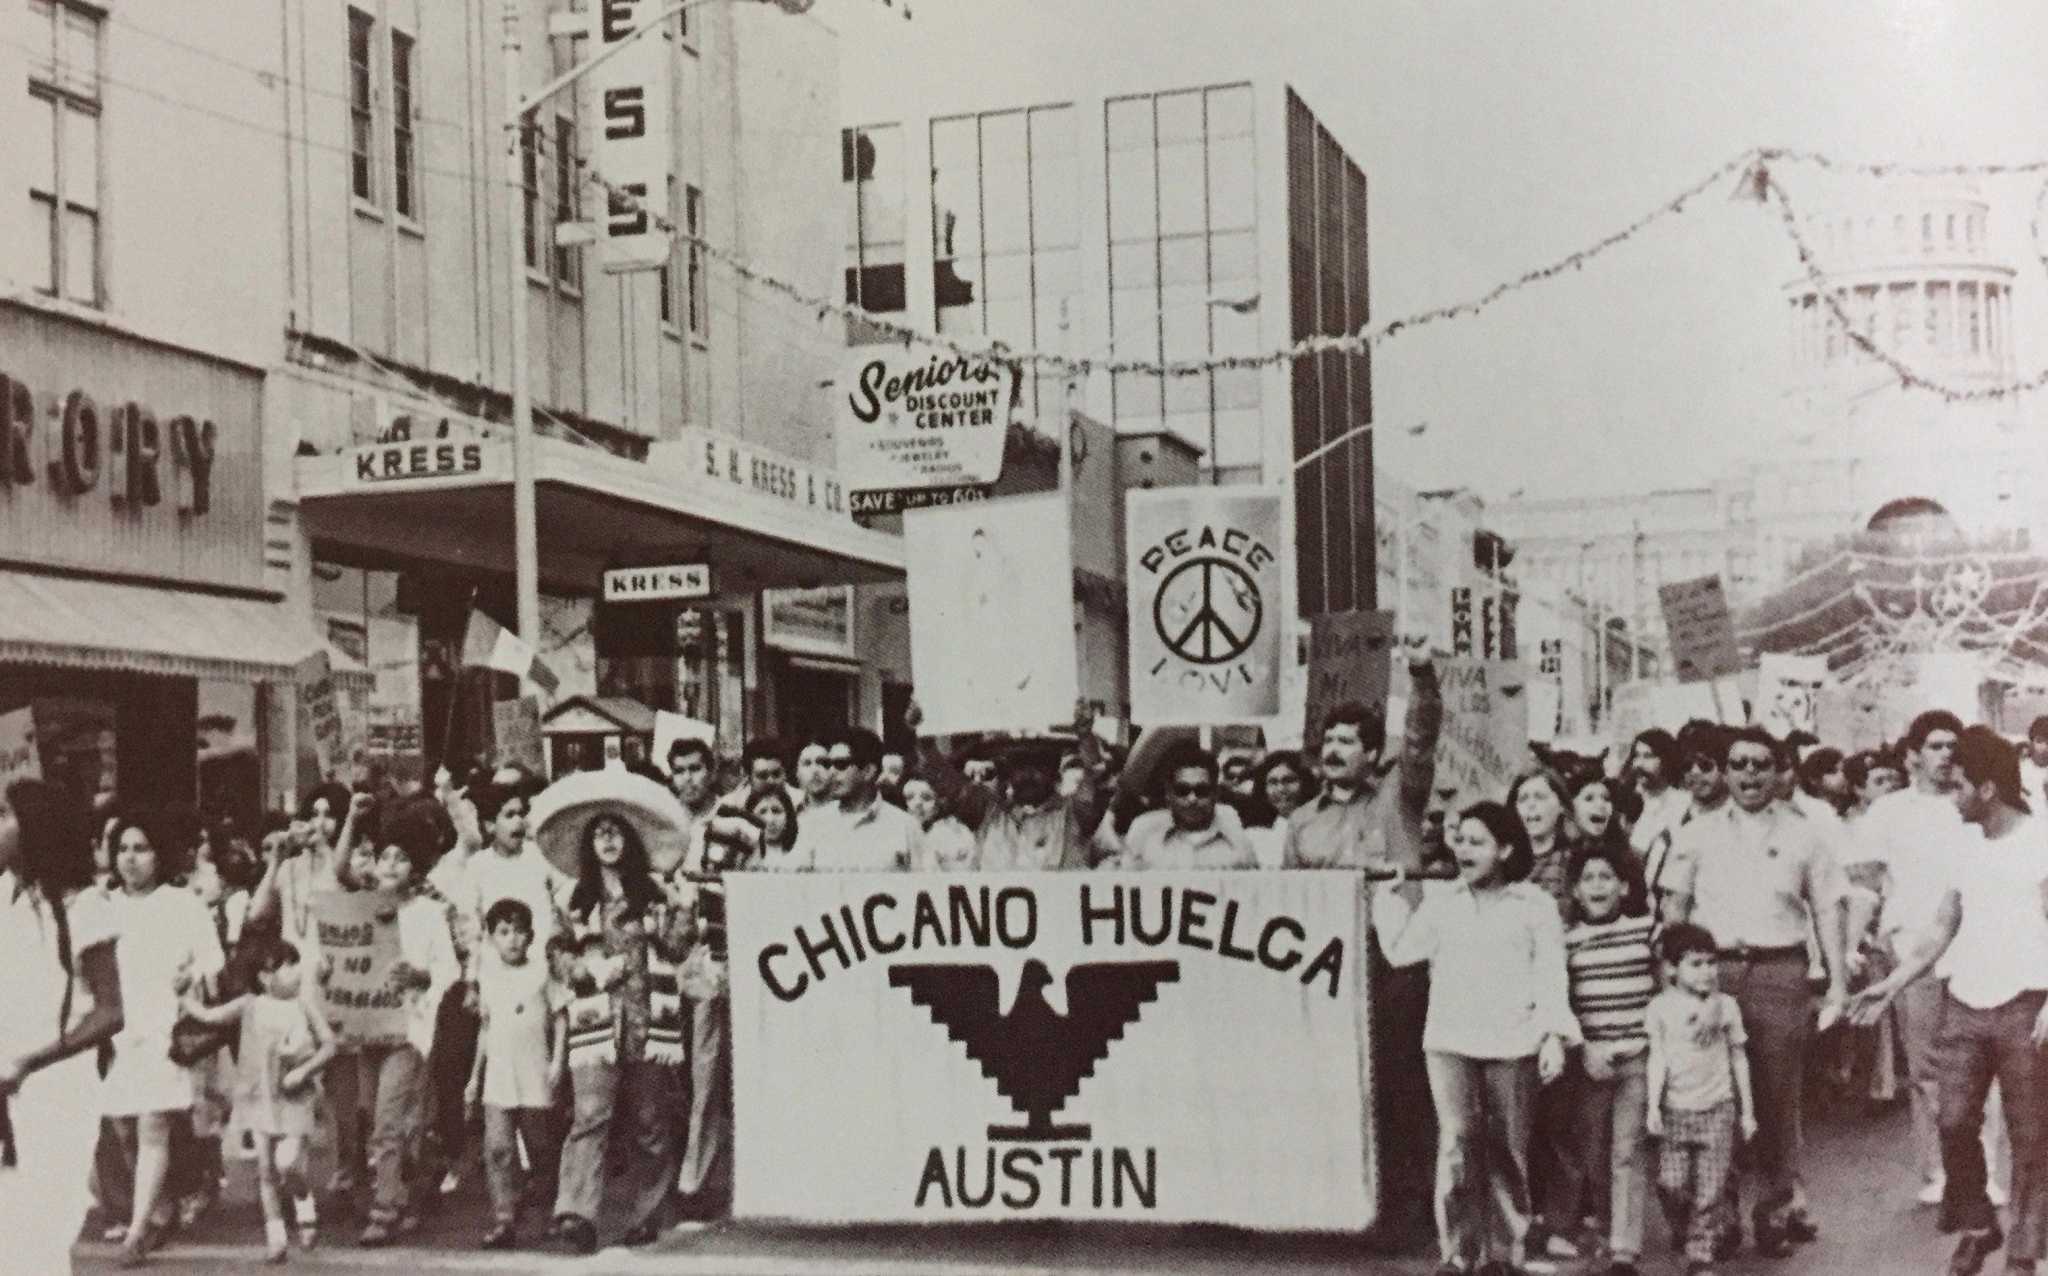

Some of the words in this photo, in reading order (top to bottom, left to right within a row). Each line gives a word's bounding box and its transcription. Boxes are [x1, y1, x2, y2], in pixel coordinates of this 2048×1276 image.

[907, 389, 998, 412] DISCOUNT
[916, 408, 992, 429] CENTER
[357, 444, 480, 480] KRESS
[752, 457, 795, 499] KRESS
[850, 491, 895, 511] SAVE
[1140, 525, 1274, 574] PEACE
[613, 571, 700, 593] KRESS
[757, 885, 1037, 1001] CHICANO
[1080, 885, 1344, 998] HUELGA
[914, 1146, 1156, 1208] AUSTIN
